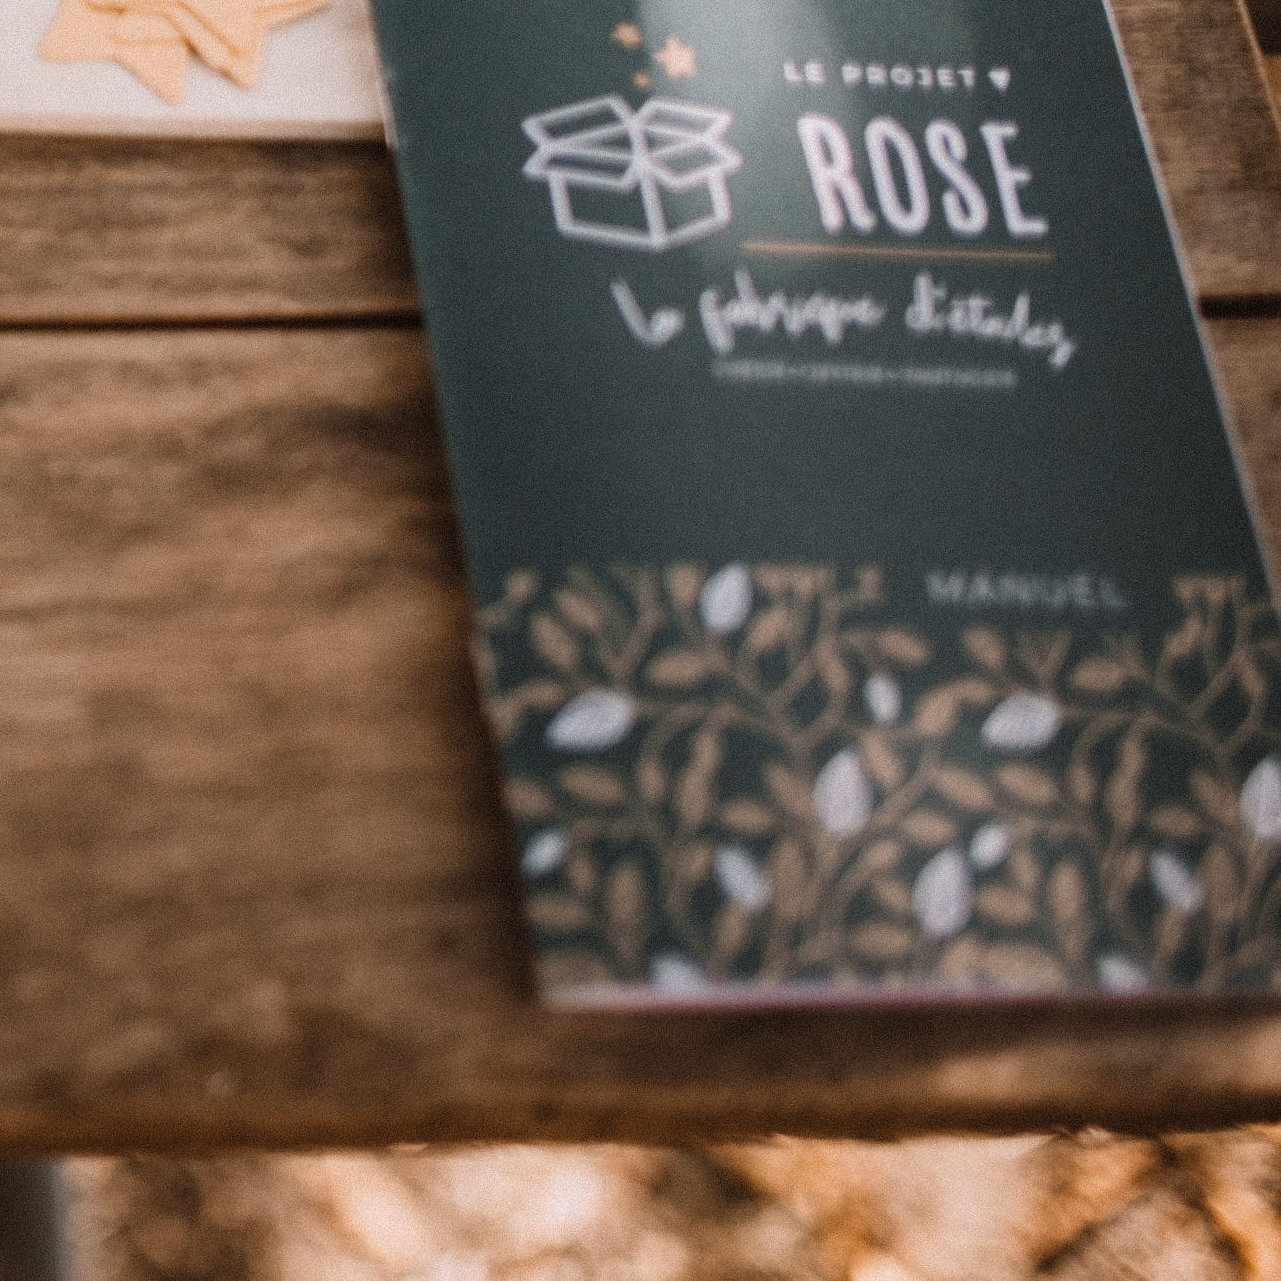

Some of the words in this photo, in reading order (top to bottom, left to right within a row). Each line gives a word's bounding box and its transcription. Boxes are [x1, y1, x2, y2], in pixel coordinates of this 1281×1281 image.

[783, 60, 826, 85] LE
[841, 61, 978, 89] PROJET
[797, 112, 1049, 239] ROSE
